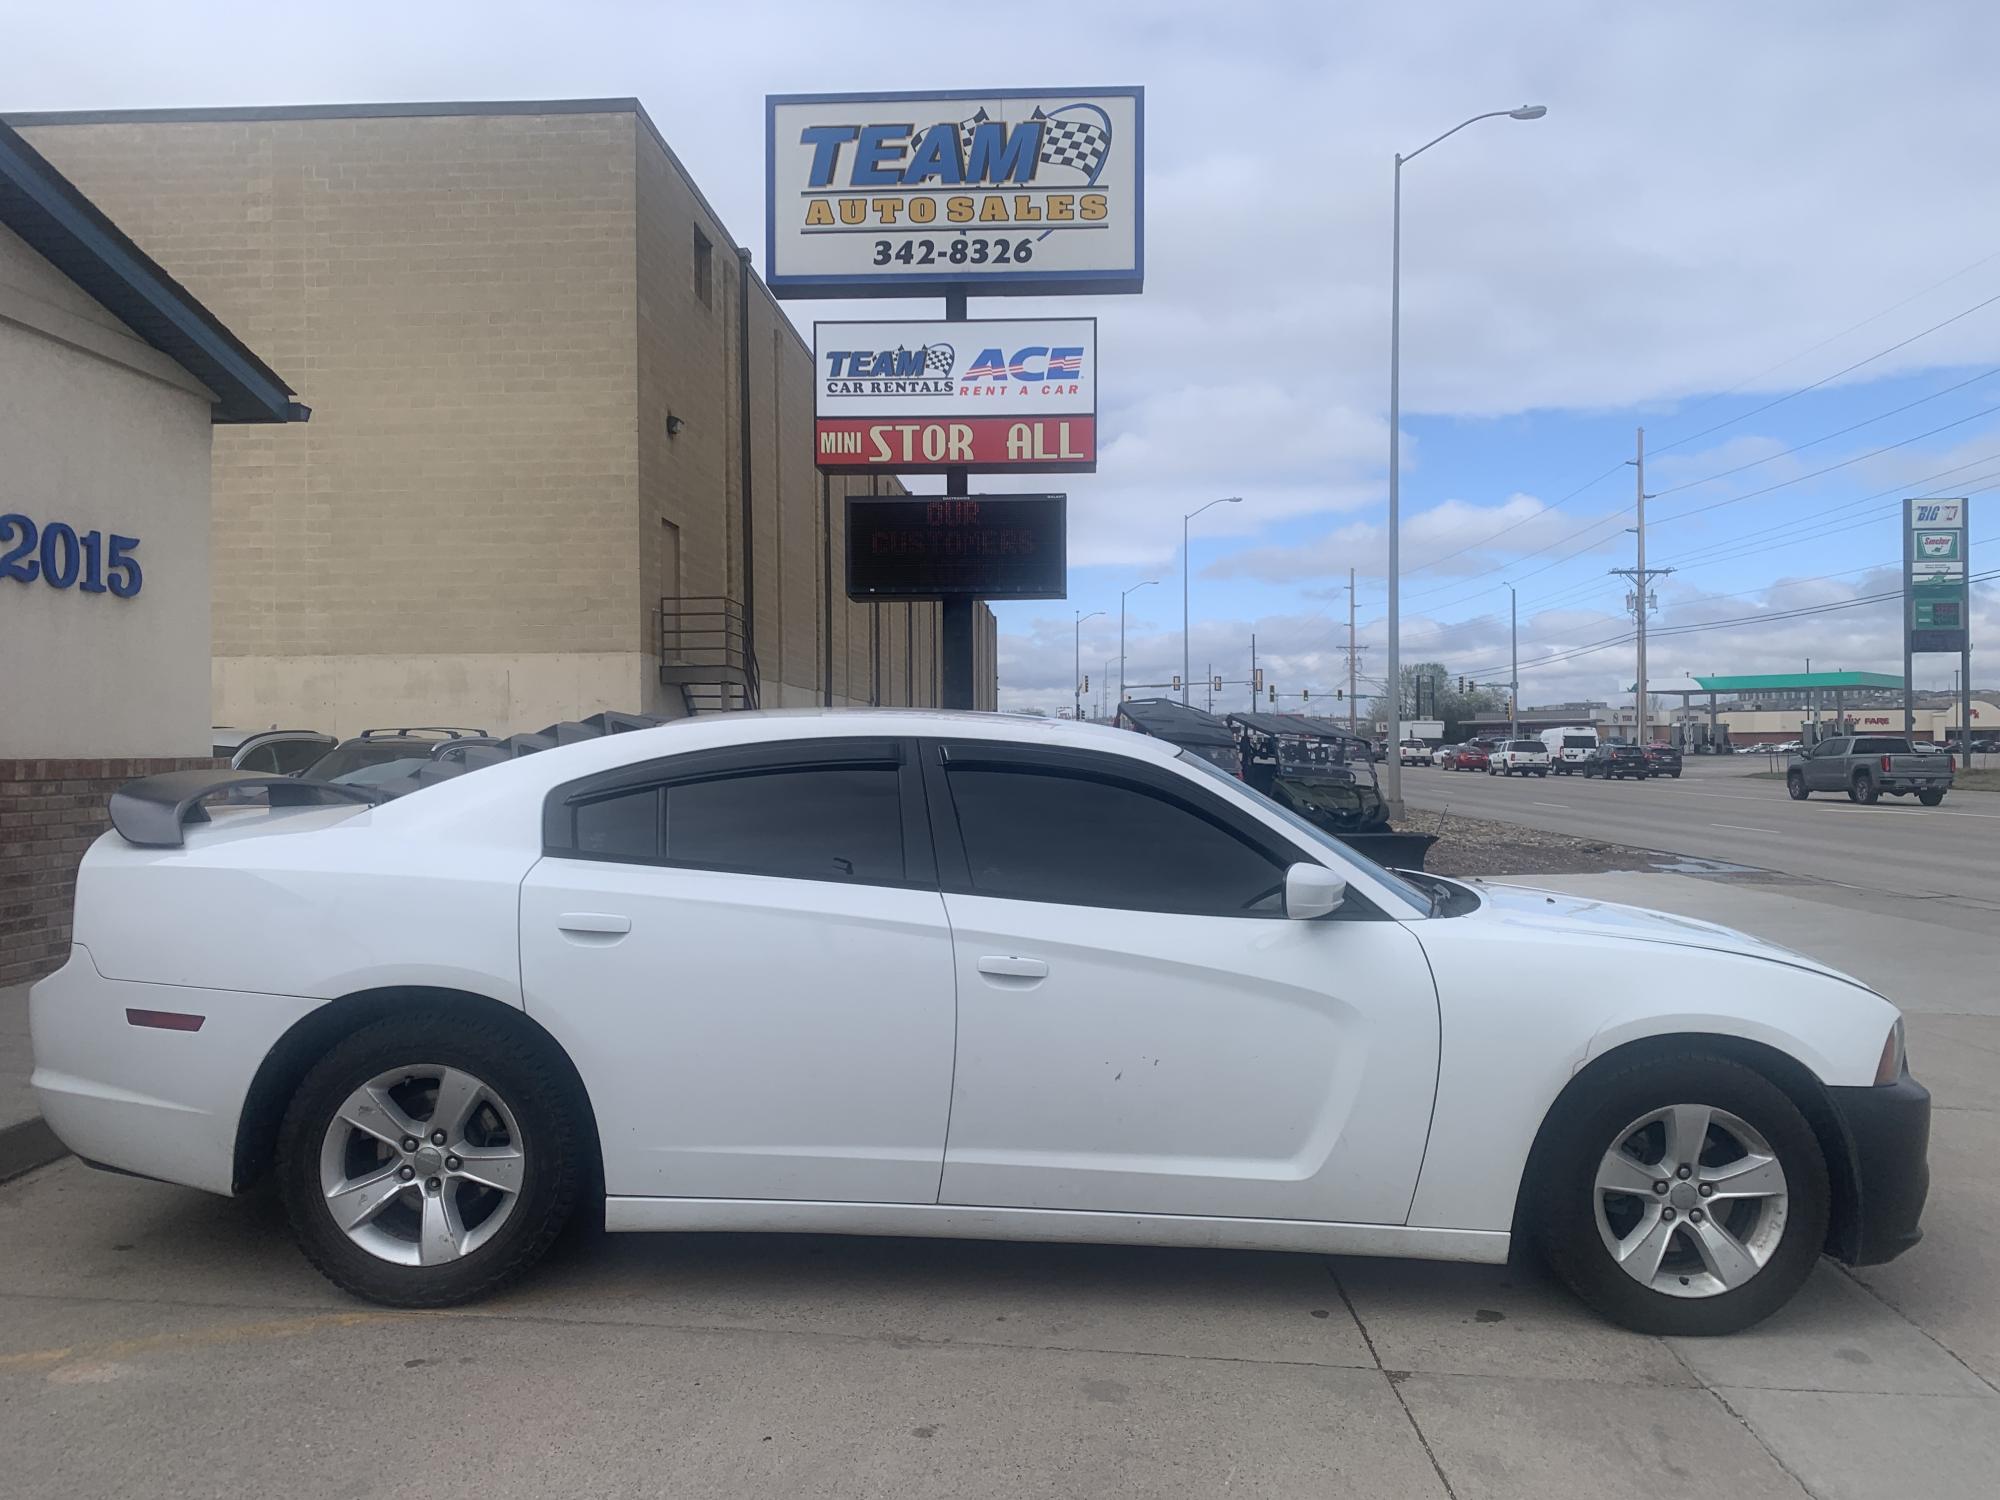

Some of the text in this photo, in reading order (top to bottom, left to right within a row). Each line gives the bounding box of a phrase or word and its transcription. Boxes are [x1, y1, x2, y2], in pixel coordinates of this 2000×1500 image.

[800, 120, 1047, 188] TEAM
[805, 194, 1108, 225] AUTO SALES
[873, 238, 1033, 266] 342-8326
[826, 349, 927, 378] TEAM
[961, 346, 1084, 382] ACE
[827, 380, 955, 394] CAR RENTALS
[960, 384, 1079, 396] RENT A CAR
[820, 422, 1084, 462] MINI STOR ALL
[1917, 506, 1940, 521] BIG
[1924, 536, 1951, 546] Sinclair
[0, 513, 143, 599] 2015
